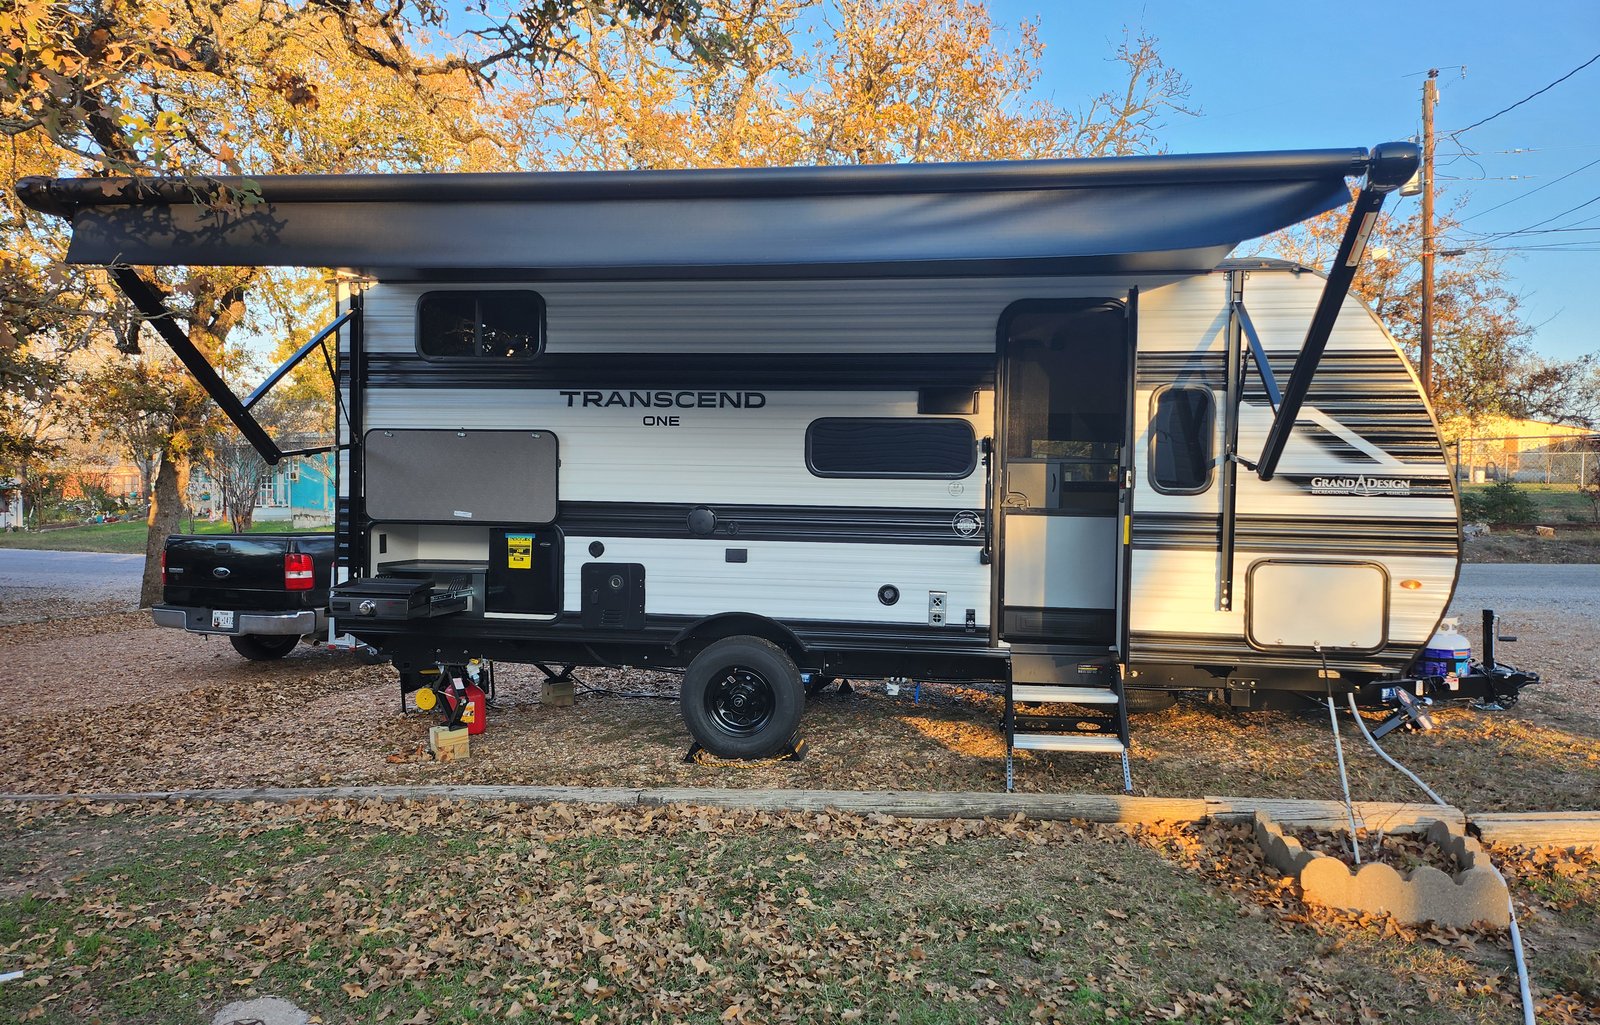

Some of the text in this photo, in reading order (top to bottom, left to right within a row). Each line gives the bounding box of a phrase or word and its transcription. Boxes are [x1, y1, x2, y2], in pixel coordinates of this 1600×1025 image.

[559, 390, 766, 409] TRANSCEND
[642, 415, 680, 427] ONE
[1311, 477, 1410, 488] GRAND DESIGN
